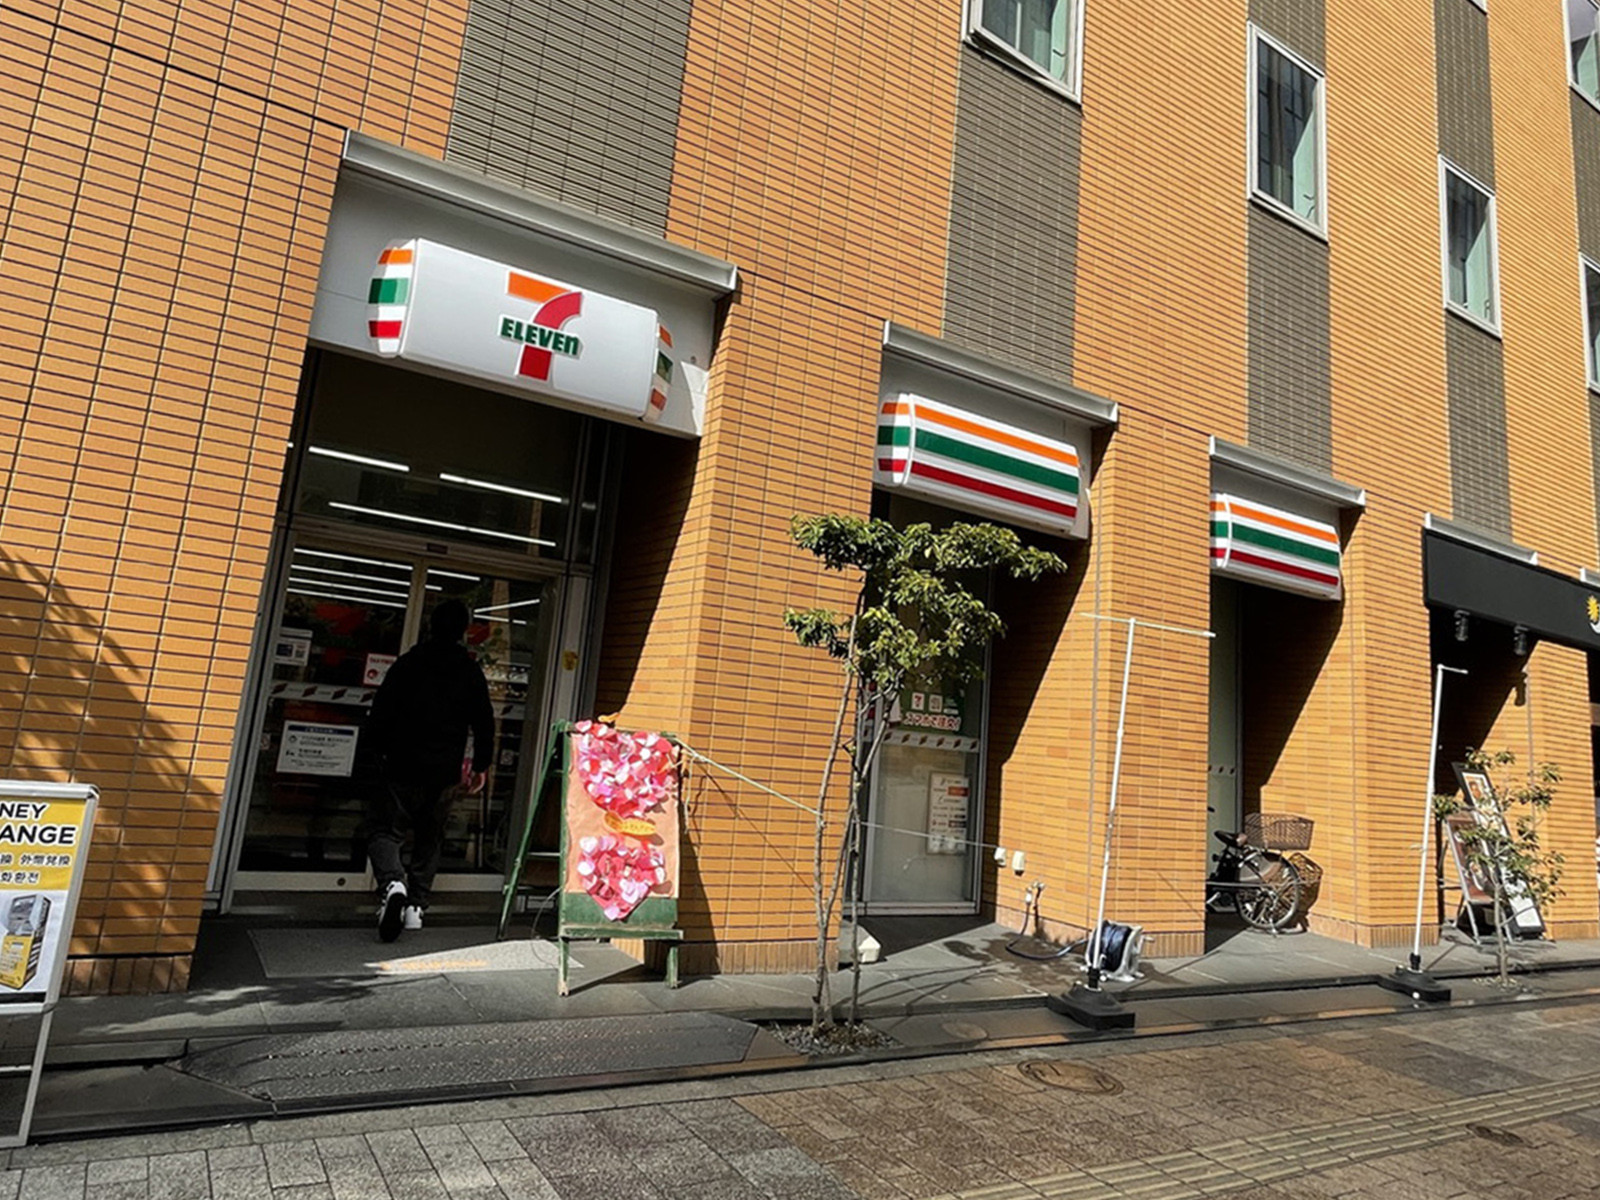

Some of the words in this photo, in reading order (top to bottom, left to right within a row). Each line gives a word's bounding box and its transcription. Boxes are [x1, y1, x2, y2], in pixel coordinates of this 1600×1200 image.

[508, 271, 582, 381] 7
[0, 803, 47, 819] NEY
[0, 825, 76, 844] ANGE
